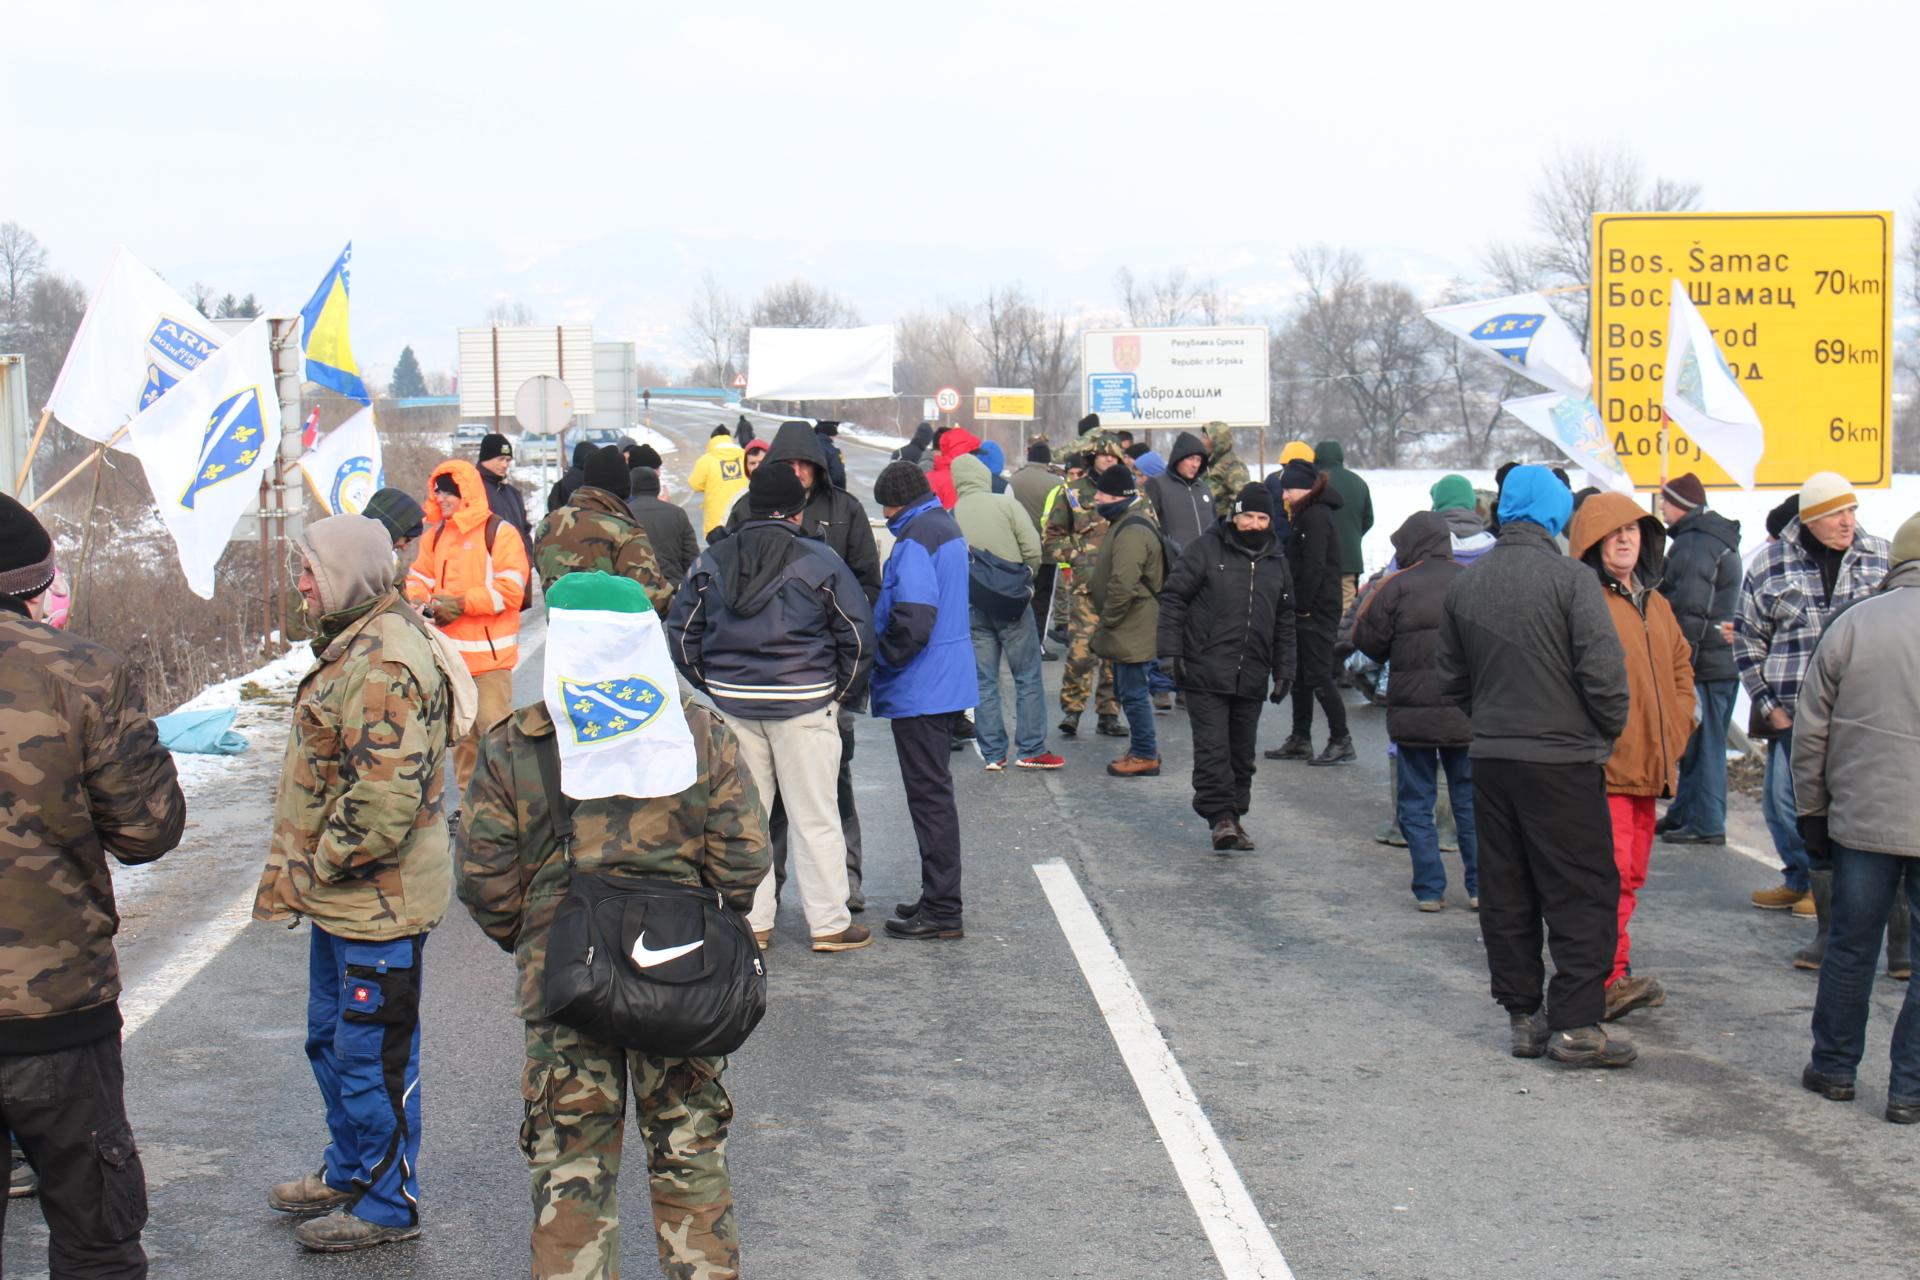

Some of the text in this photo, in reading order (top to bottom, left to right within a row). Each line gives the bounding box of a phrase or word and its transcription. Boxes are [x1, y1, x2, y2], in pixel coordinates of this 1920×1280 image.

[1609, 240, 1789, 273] Bos. Šamac
[1688, 281, 1795, 308] Шамац
[940, 393, 956, 406] 50
[1131, 406, 1196, 419] Welcome!
